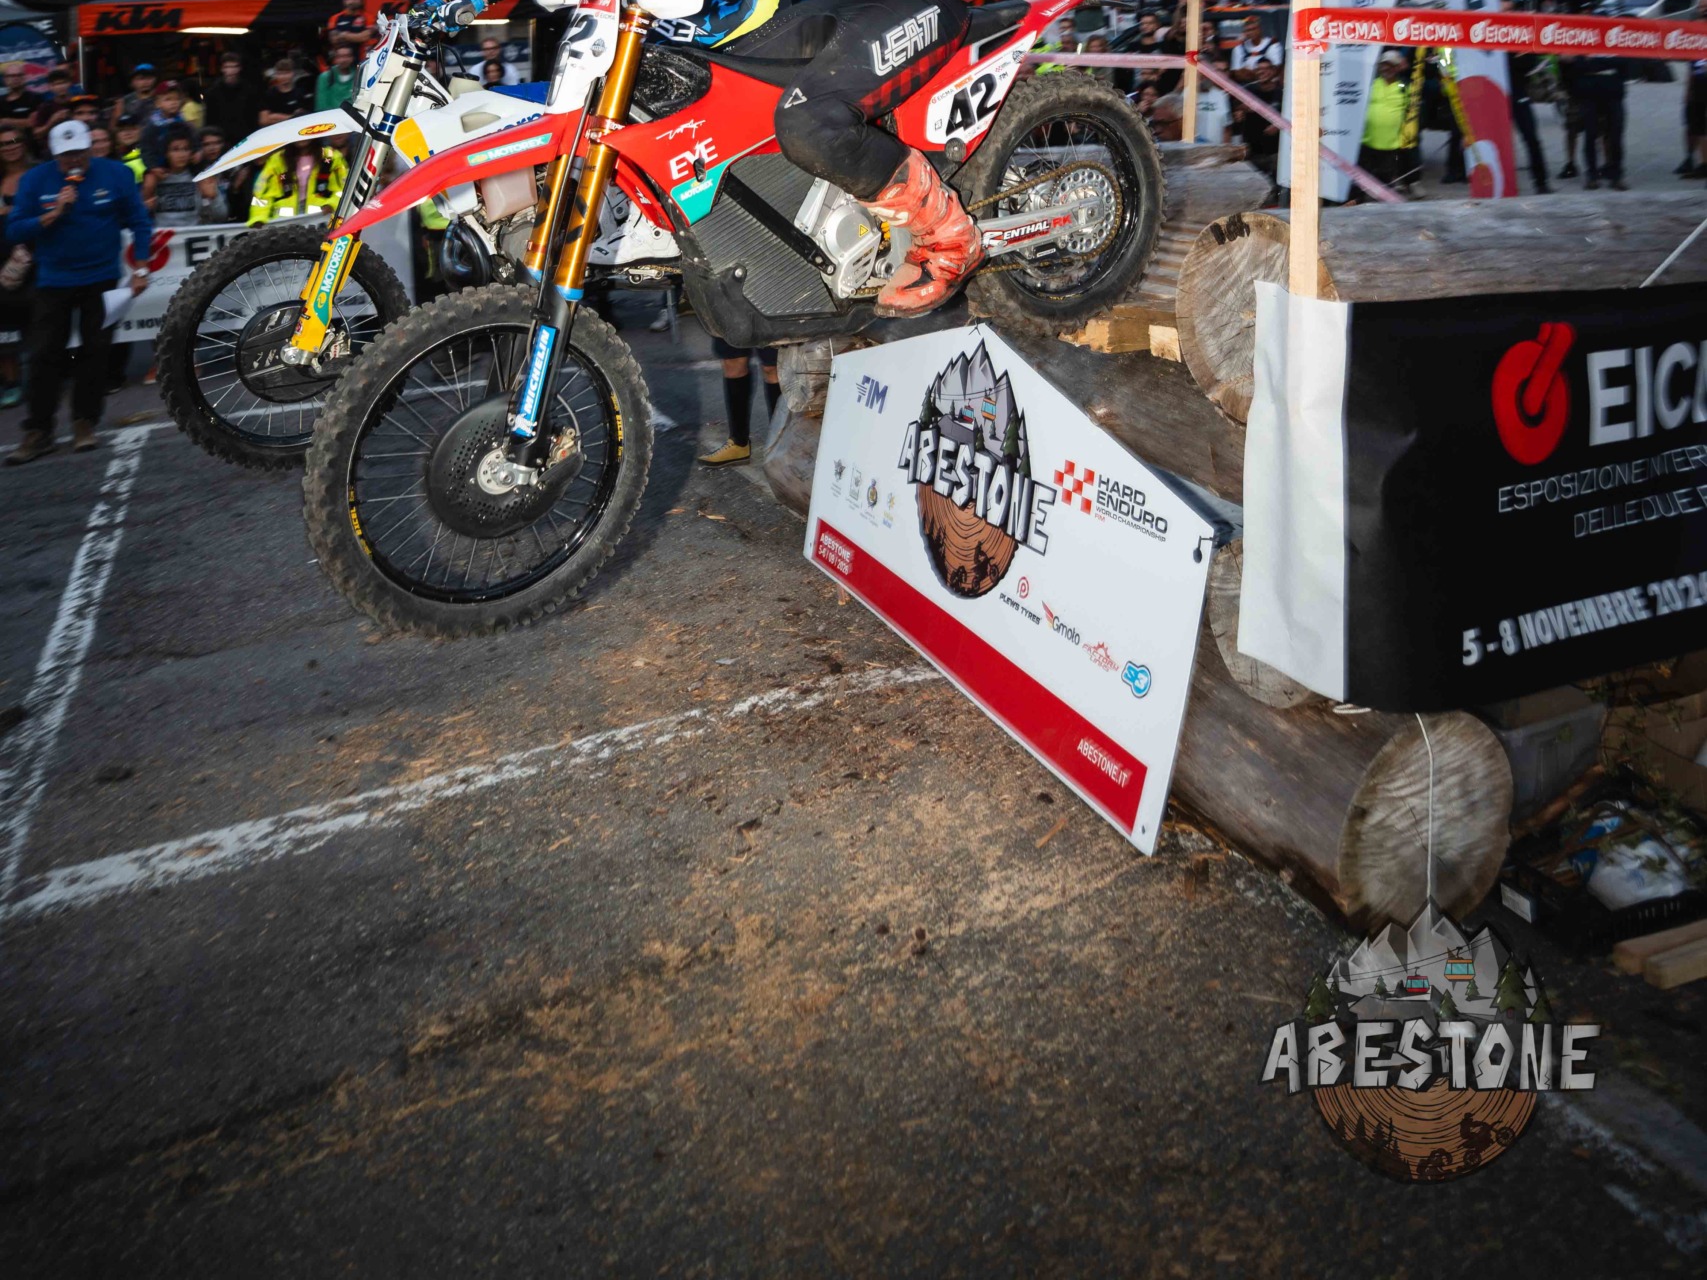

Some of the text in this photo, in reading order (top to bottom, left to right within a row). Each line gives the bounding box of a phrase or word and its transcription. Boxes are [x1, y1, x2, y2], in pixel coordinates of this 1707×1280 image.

[94, 4, 185, 32] KTM
[1327, 20, 1382, 41] EICMA
[1409, 22, 1460, 42] EICMA
[1485, 23, 1530, 45] EICMA
[1554, 26, 1597, 46] EICMA
[1616, 28, 1658, 49] EICMA
[871, 4, 941, 77] LEATT
[945, 73, 1003, 137] 42
[488, 137, 546, 160] MOTOREX
[669, 137, 719, 181] EVE
[679, 178, 714, 201] MOTOREX
[1051, 214, 1073, 229] RK
[320, 239, 348, 293] MOTOREX
[522, 328, 551, 415] MICHELIN
[856, 375, 889, 414] FIM
[898, 420, 1058, 557] ABESTONE
[1097, 474, 1146, 507] HARD
[1498, 457, 1649, 513] ESPOSIZIONE
[1094, 513, 1106, 523] FIM
[1095, 505, 1167, 542] WORLD CHAMPIONSHIP
[1096, 489, 1168, 534] ENDURO
[820, 533, 850, 562] ABESTONE
[999, 593, 1041, 626] PLEWS TYRES
[1462, 628, 1481, 666] 5
[1499, 619, 1520, 657] 8
[1518, 586, 1653, 651] NOVEMBRE
[1052, 615, 1081, 646] Gmoto
[1077, 738, 1128, 789] ABESTONE.IT
